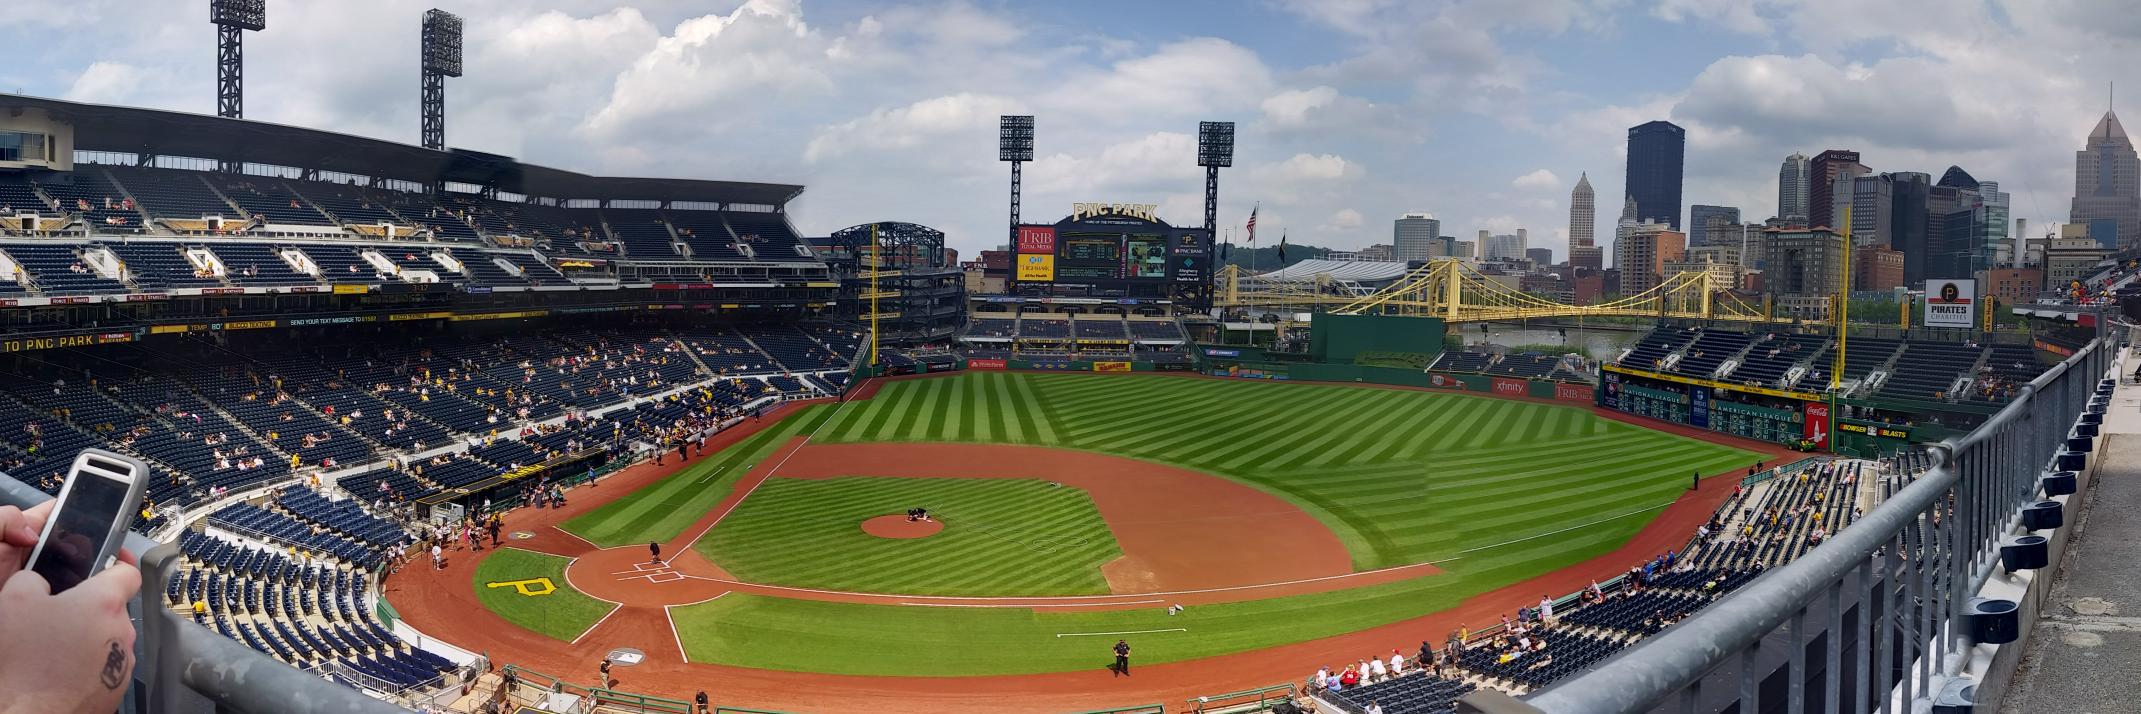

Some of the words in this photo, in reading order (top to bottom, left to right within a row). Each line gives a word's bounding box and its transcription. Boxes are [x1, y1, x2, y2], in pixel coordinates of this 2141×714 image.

[1073, 203, 1108, 222] PNC
[1112, 203, 1157, 223] PARK
[1021, 230, 1052, 243] TRIB
[1947, 287, 1954, 300] P
[1931, 305, 1967, 314] PIRATES
[5, 341, 19, 352] TO
[26, 338, 54, 350] PNC
[60, 335, 94, 348] PARK
[1496, 382, 1524, 393] xfinity
[1557, 386, 1578, 399] TRIB
[1624, 389, 1654, 399] NATIONAL
[1655, 394, 1680, 404] LEAGUE
[1718, 406, 1757, 417] AMERICAN
[1759, 412, 1792, 422] LEAGUE
